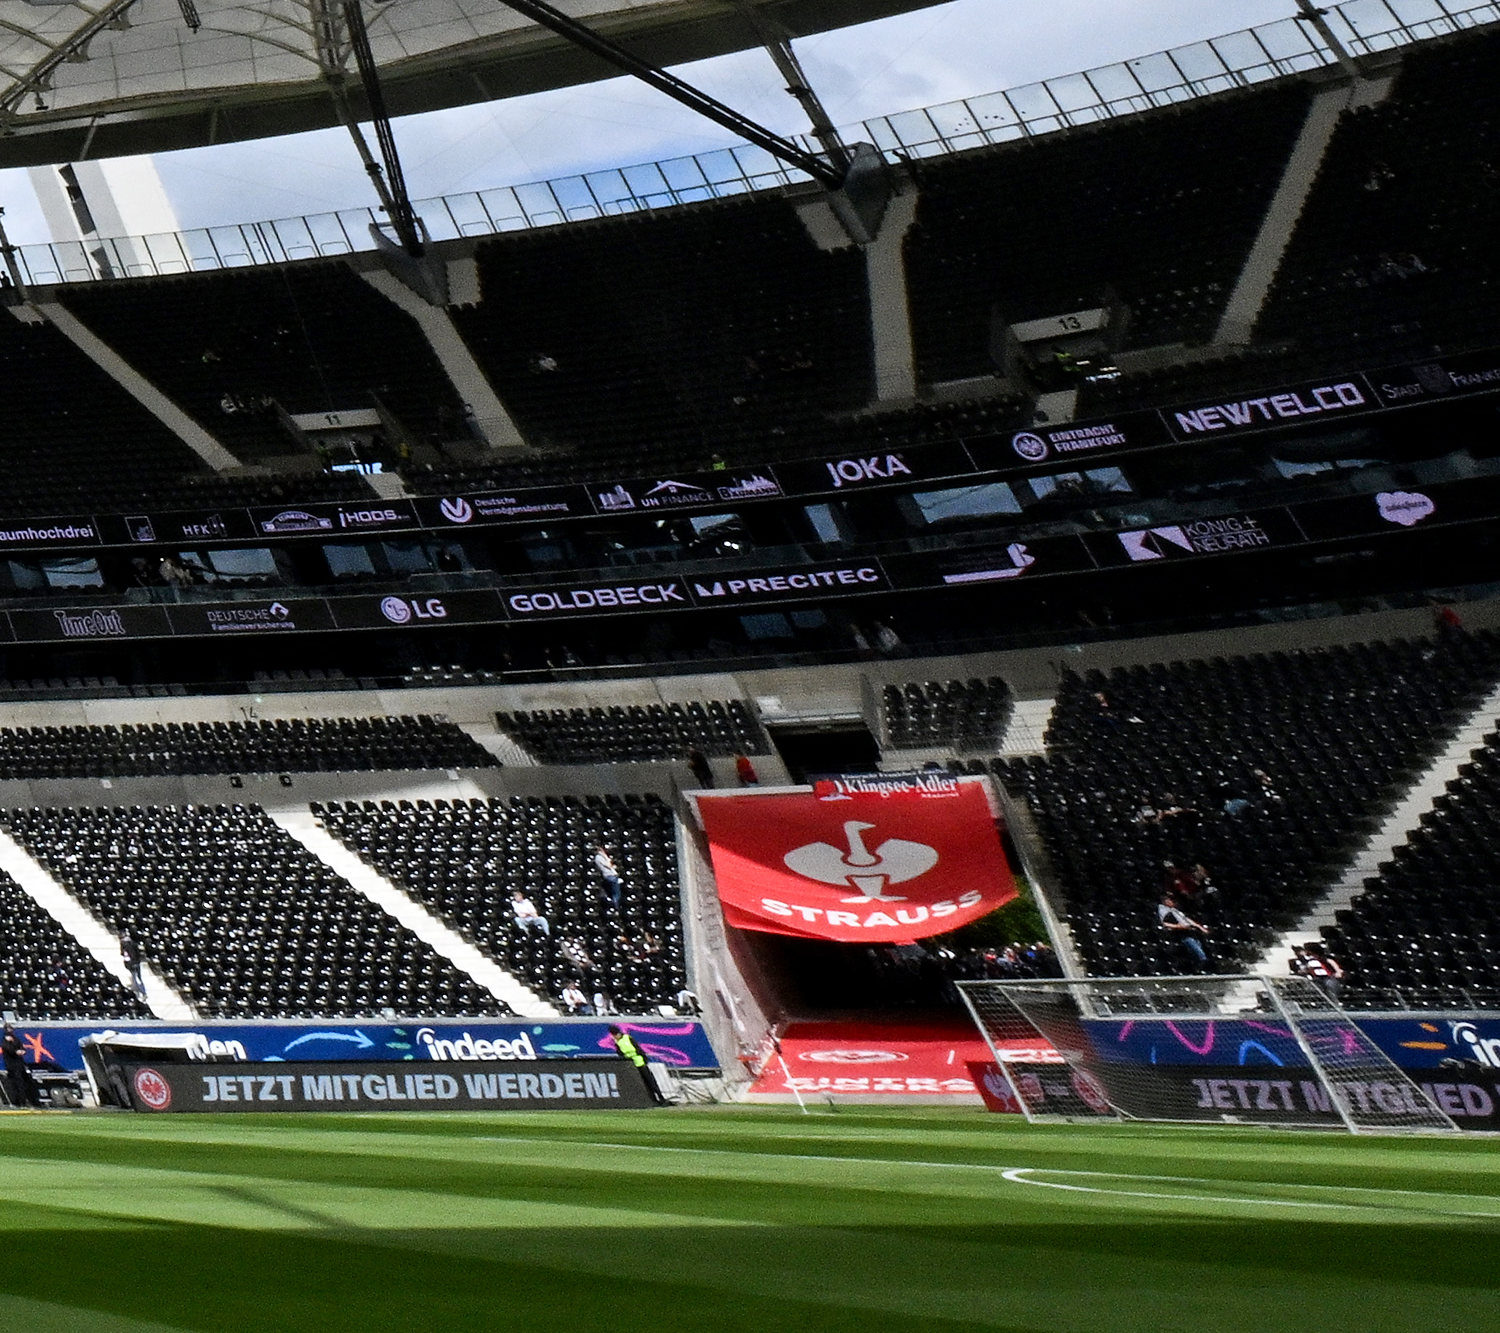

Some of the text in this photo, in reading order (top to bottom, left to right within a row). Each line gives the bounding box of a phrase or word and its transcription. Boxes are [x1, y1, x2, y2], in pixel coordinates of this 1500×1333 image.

[1059, 315, 1082, 331] 13
[325, 414, 341, 424] 11
[1174, 383, 1366, 433] NEWTELCO
[1049, 423, 1118, 443] EINTRACHT
[1052, 432, 1127, 453] FRANKFURT
[825, 454, 911, 487] JOKA
[661, 492, 716, 506] FINANCE
[728, 567, 880, 595] PRECITEC
[411, 598, 448, 619] LG
[510, 582, 685, 612] GOLDBECK
[206, 608, 270, 622] DEUTSCHE
[761, 889, 983, 928] STRAUSS
[417, 1028, 538, 1060] indeed
[202, 1072, 621, 1102] JETZT MITGLIED WERDEN!
[1193, 1079, 1494, 1117] JETZT MTGLIED
